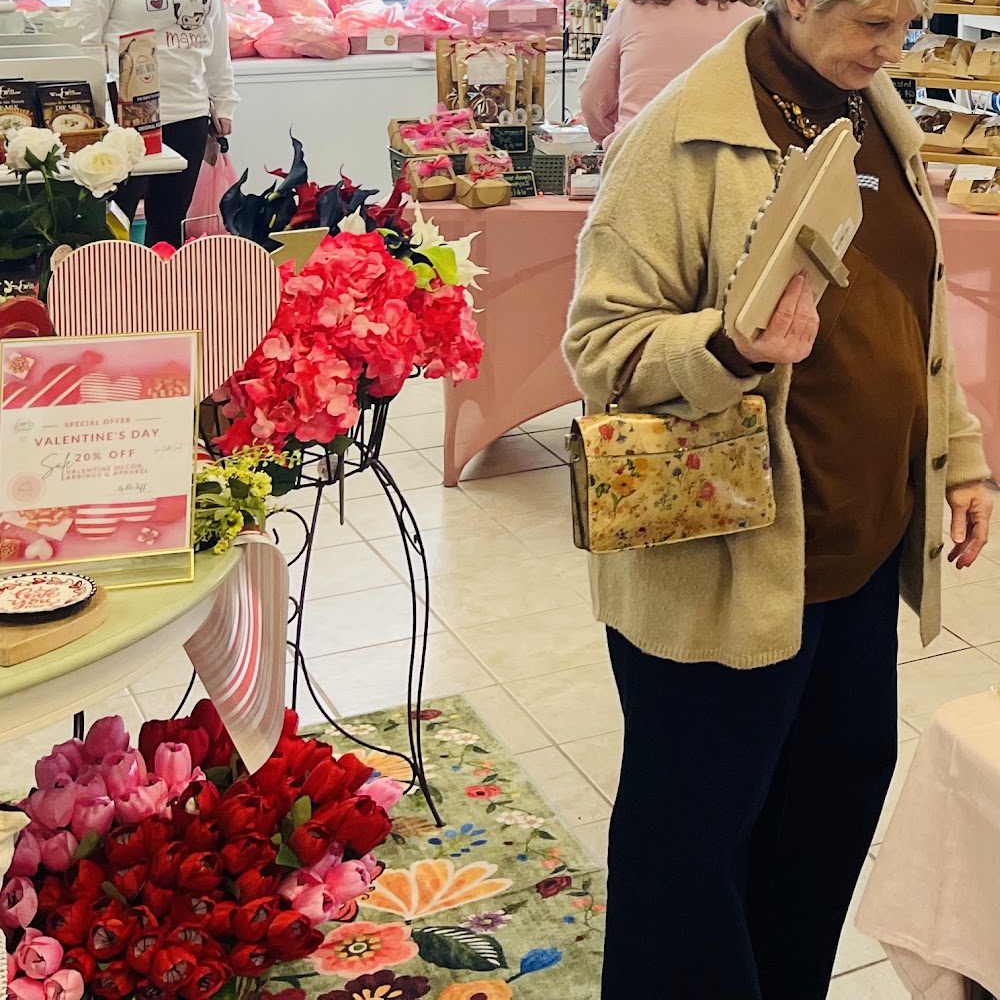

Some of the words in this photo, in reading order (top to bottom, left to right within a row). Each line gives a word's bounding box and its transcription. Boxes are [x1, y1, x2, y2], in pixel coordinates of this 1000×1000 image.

[64, 420, 99, 428] SPECIAL
[103, 417, 131, 425] OFFER
[35, 431, 126, 446] VALENTINE'S
[131, 428, 160, 439] DAY
[75, 451, 103, 462] 20%
[109, 448, 136, 459] OFF
